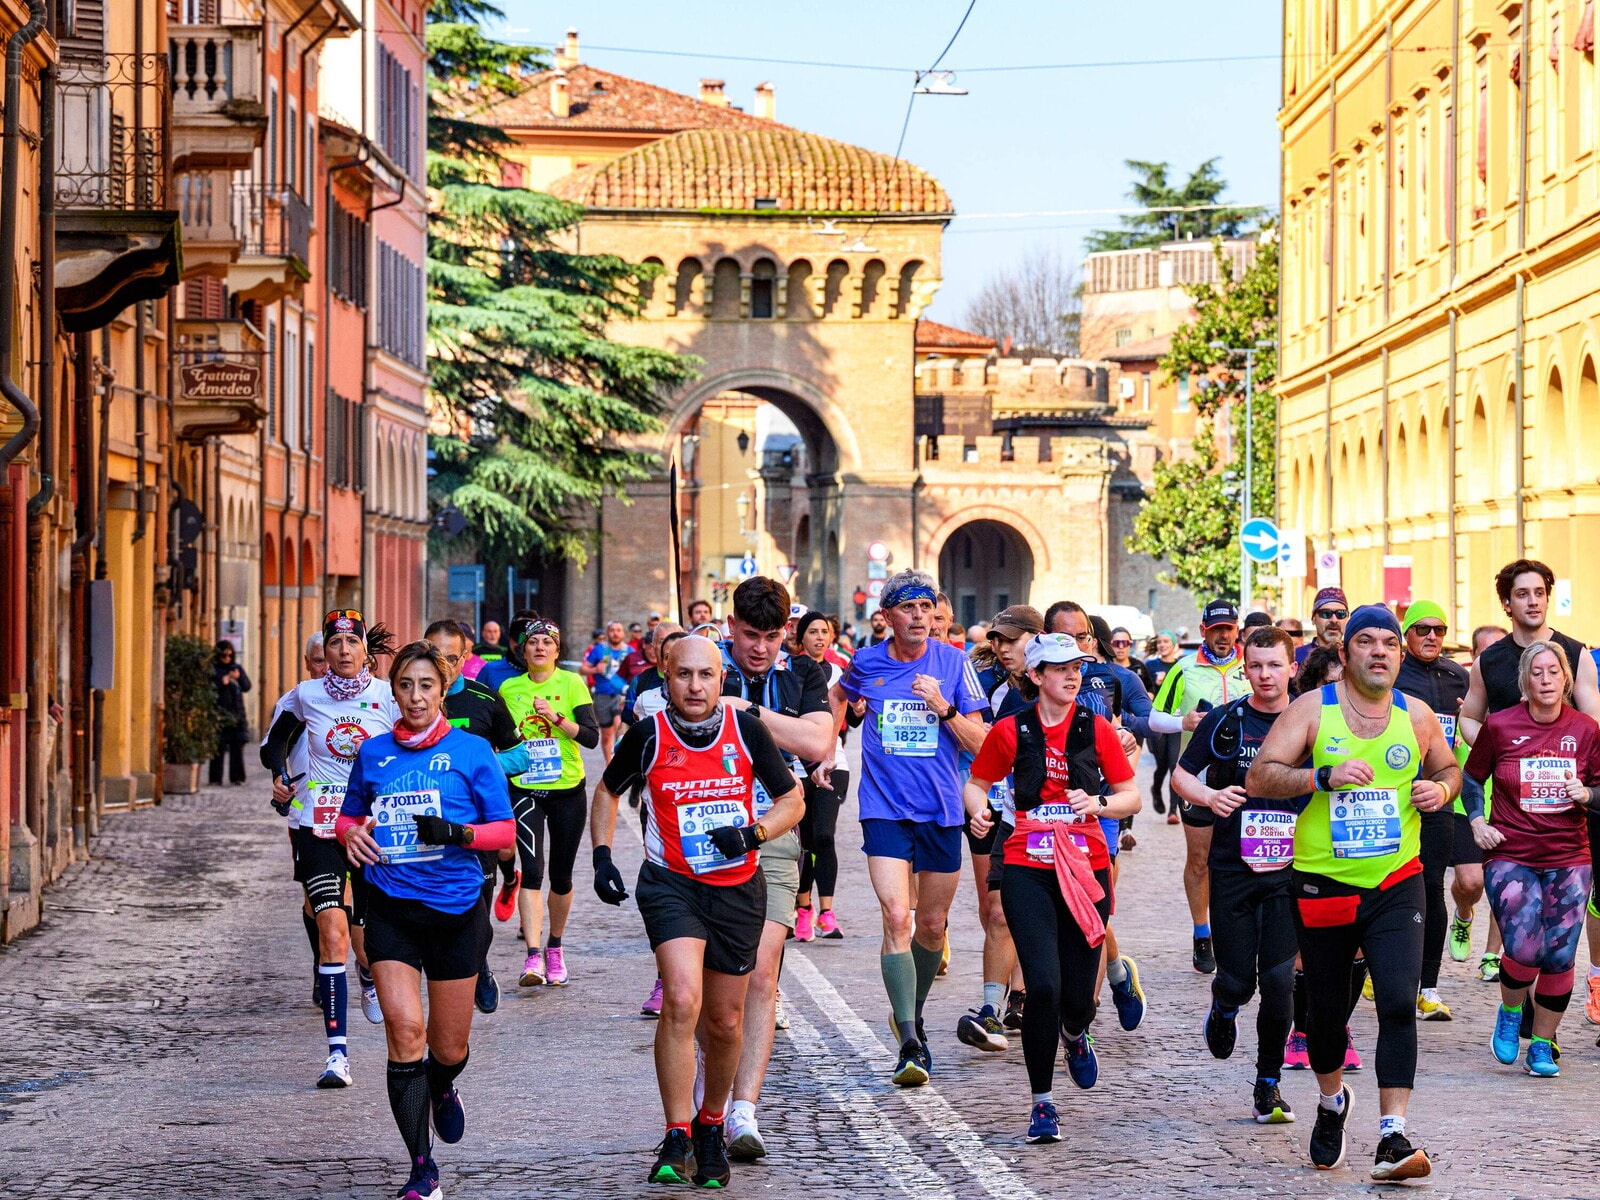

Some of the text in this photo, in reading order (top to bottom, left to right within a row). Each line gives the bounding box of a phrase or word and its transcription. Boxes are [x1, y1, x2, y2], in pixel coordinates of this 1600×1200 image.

[190, 368, 251, 382] Trattoria
[188, 381, 252, 396] Amedeo
[334, 715, 362, 726] PASSO
[895, 731, 927, 742] 1822
[661, 776, 745, 792] RUNNER
[674, 785, 748, 801] VARESE
[1531, 787, 1567, 798] 3956
[322, 812, 339, 824] 32
[1345, 819, 1366, 827] EUGENIO
[391, 831, 425, 846] 177
[1346, 826, 1387, 841] 1735
[1253, 845, 1290, 857] 4187
